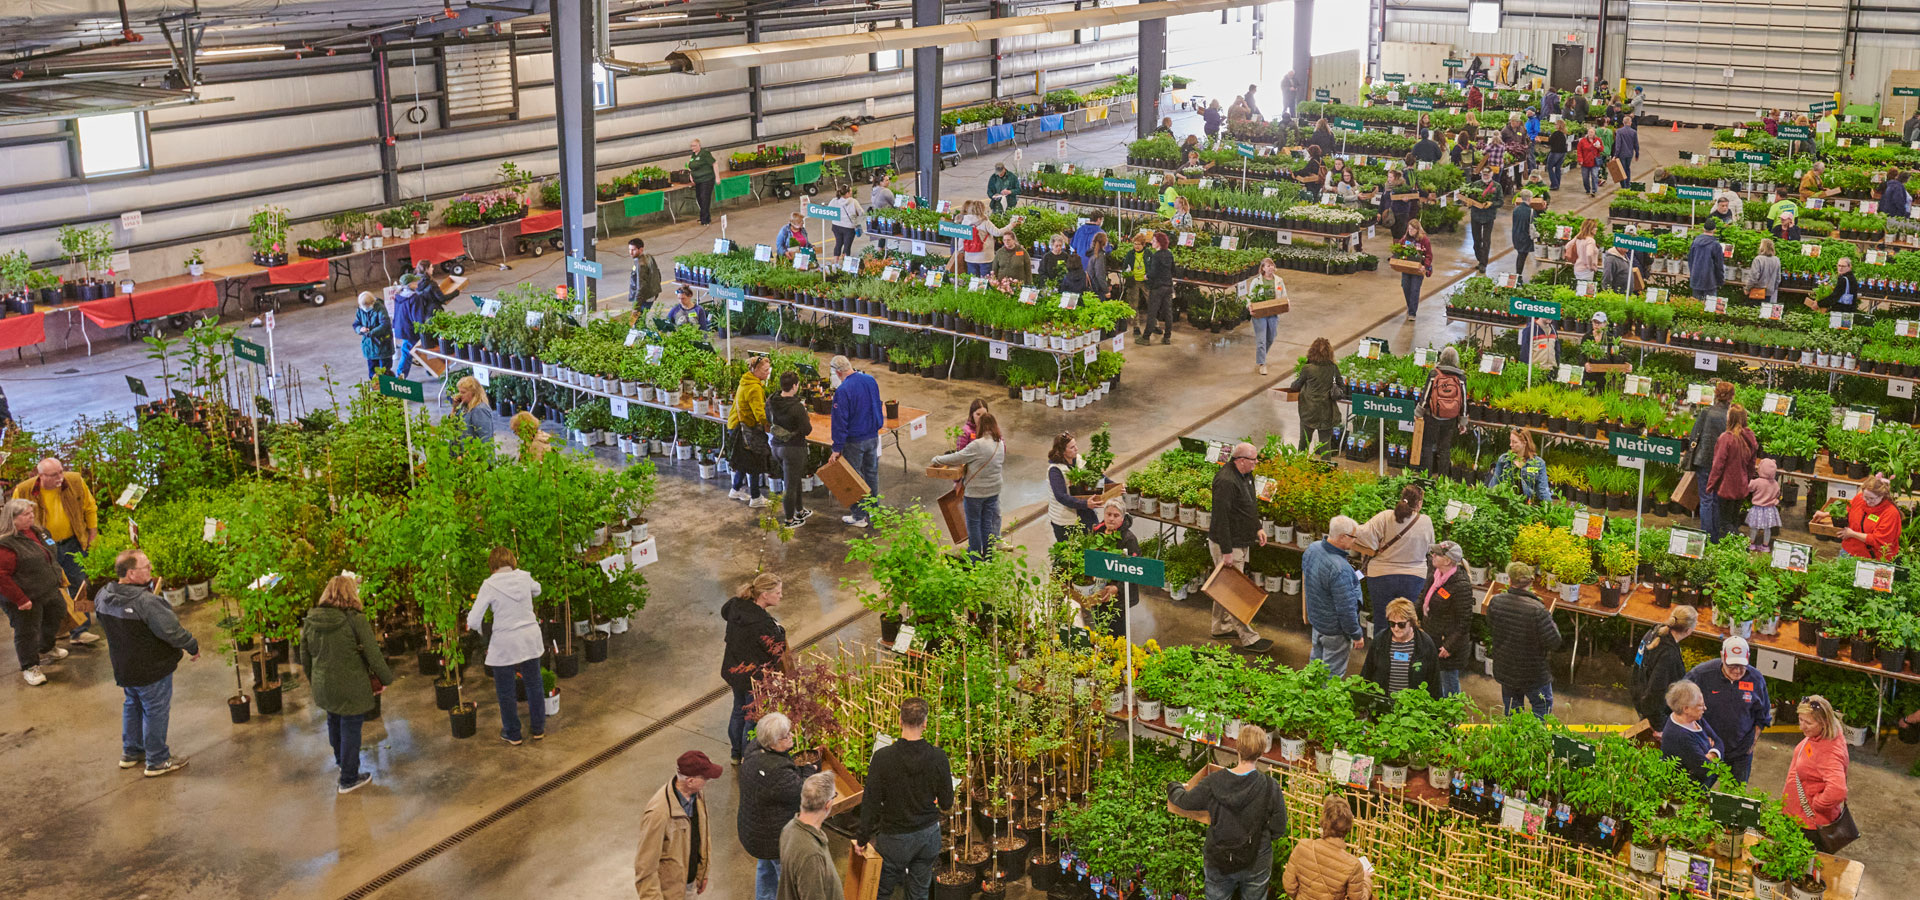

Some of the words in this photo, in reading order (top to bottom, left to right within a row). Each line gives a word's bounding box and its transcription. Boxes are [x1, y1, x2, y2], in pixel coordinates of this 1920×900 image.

[1811, 102, 1836, 110] Tomtoes
[1742, 153, 1763, 161] Ferns
[1104, 180, 1136, 189] Perennials
[1678, 188, 1712, 197] Perennials
[809, 206, 838, 217] Grasses
[939, 223, 972, 236] Perennials
[1615, 236, 1657, 249] Perennials
[573, 261, 596, 274] Shrubs
[715, 288, 738, 299] Natives
[1514, 300, 1556, 315] Grasses
[995, 347, 1002, 355] 22
[1702, 358, 1710, 366] 32
[1896, 385, 1904, 393] 31
[616, 404, 623, 412] 11
[1363, 400, 1403, 414] Shrubs
[1616, 436, 1674, 456] Natives
[1837, 489, 1847, 498] 19
[640, 548, 648, 557] 1-3
[1104, 558, 1144, 576] Vines
[1731, 646, 1742, 655] C
[1772, 659, 1778, 670] 7
